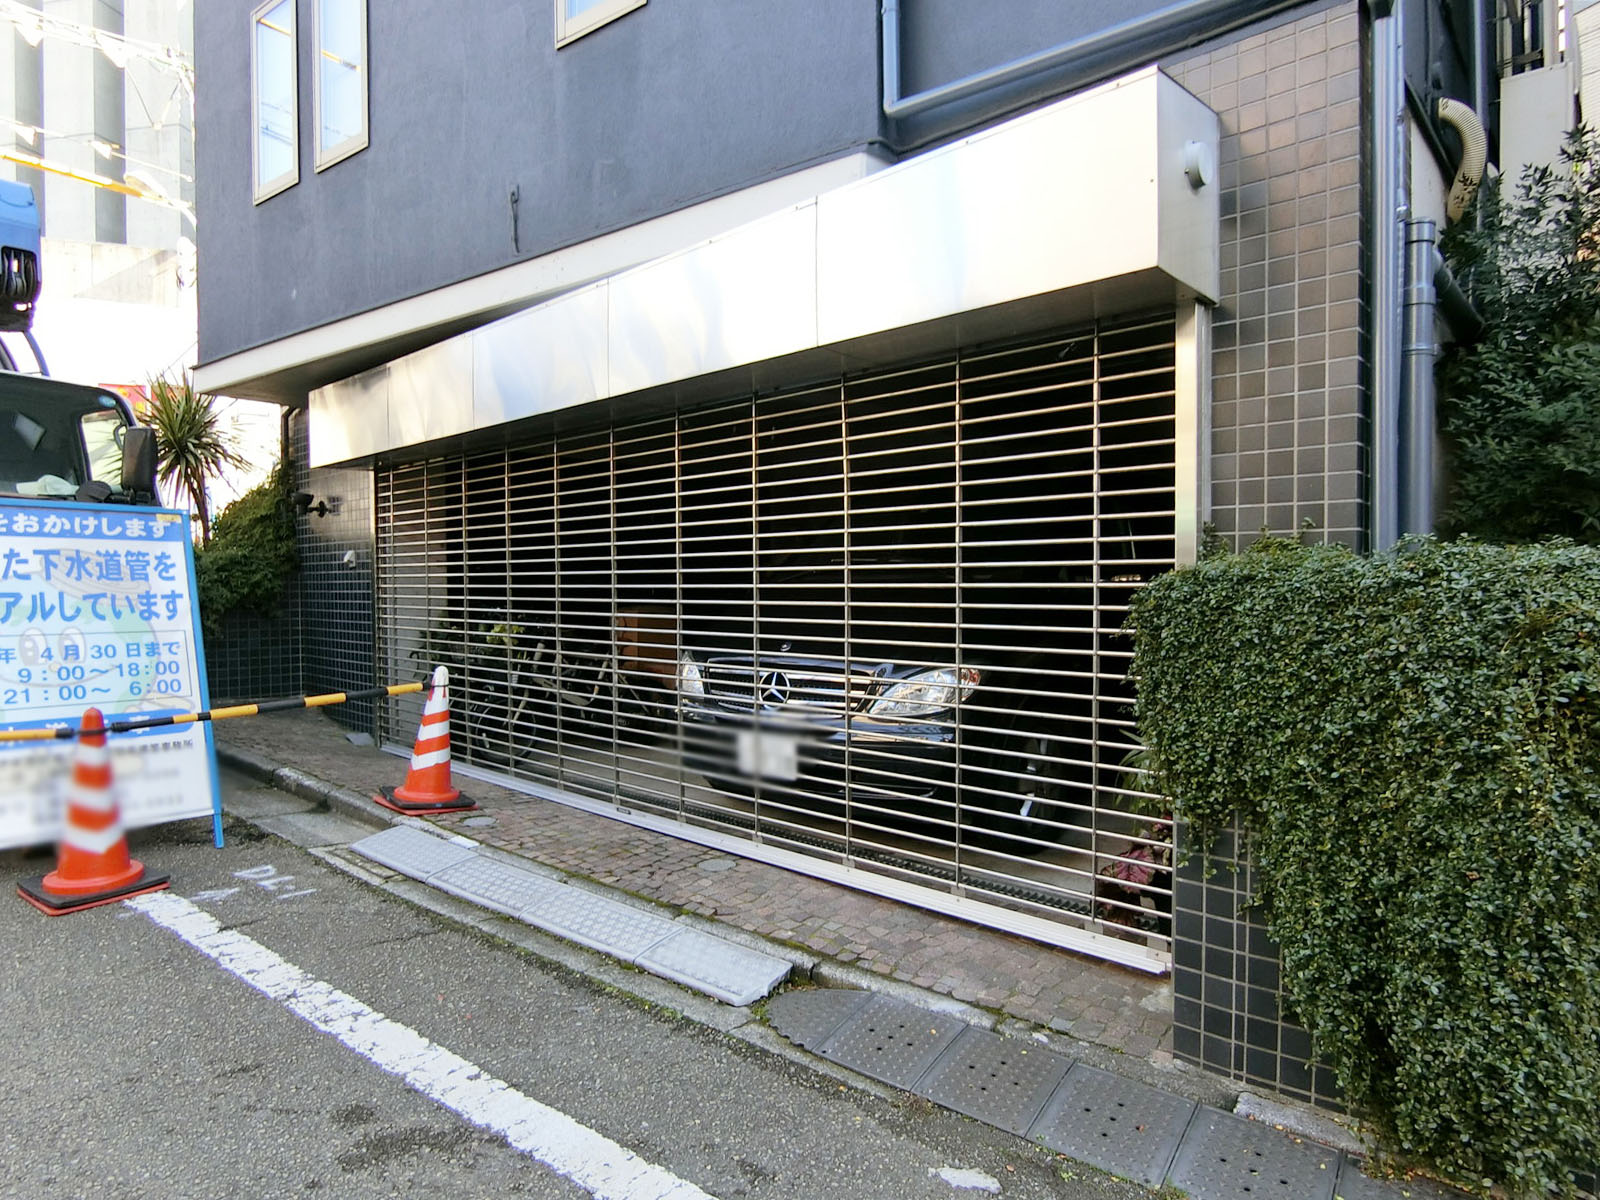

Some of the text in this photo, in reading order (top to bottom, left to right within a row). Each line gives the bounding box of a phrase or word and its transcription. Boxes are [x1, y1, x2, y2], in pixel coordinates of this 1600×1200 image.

[2, 548, 177, 582] た下水道管を
[0, 590, 184, 624] アルしています
